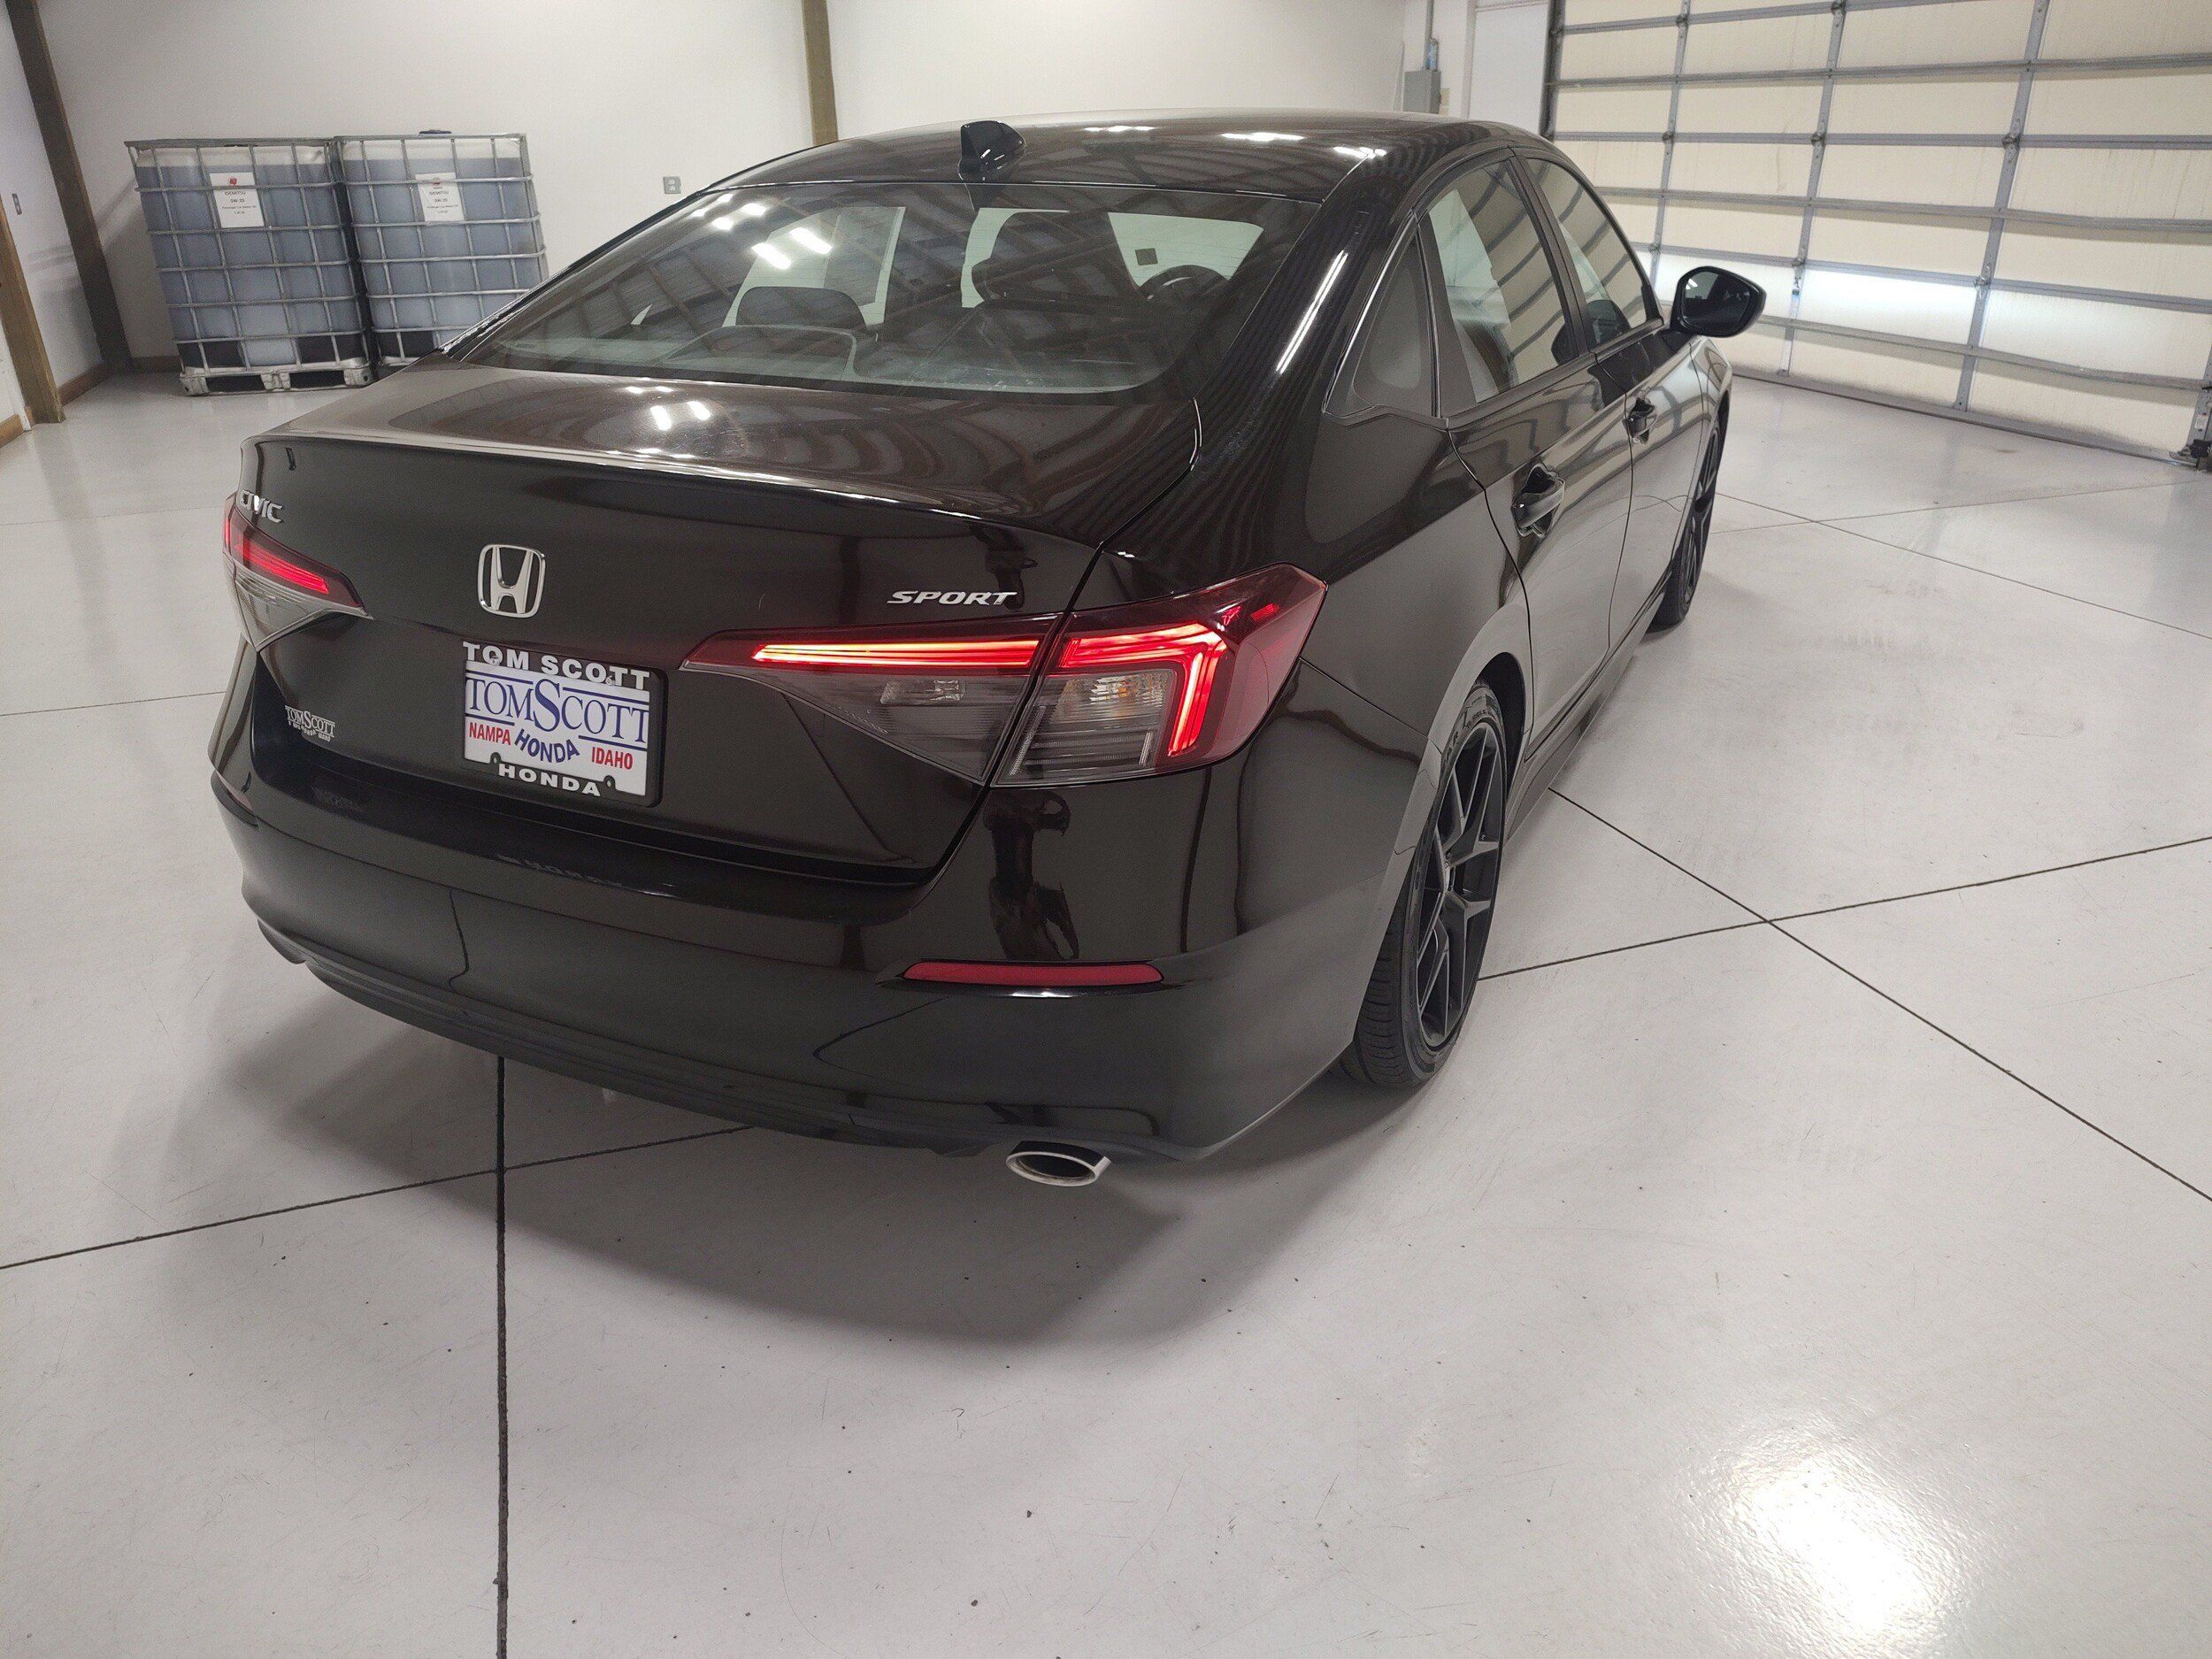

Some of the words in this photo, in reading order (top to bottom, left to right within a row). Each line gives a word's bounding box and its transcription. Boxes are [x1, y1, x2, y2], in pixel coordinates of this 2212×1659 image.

[240, 489, 283, 523] CIVIC
[887, 590, 1018, 606] SPORT
[463, 641, 529, 671] TOM
[541, 655, 649, 690] SCOTT
[469, 722, 511, 746] NAMPA
[515, 728, 580, 764] HONDA
[591, 747, 634, 771] IDAHO
[498, 764, 601, 796] HONDA
